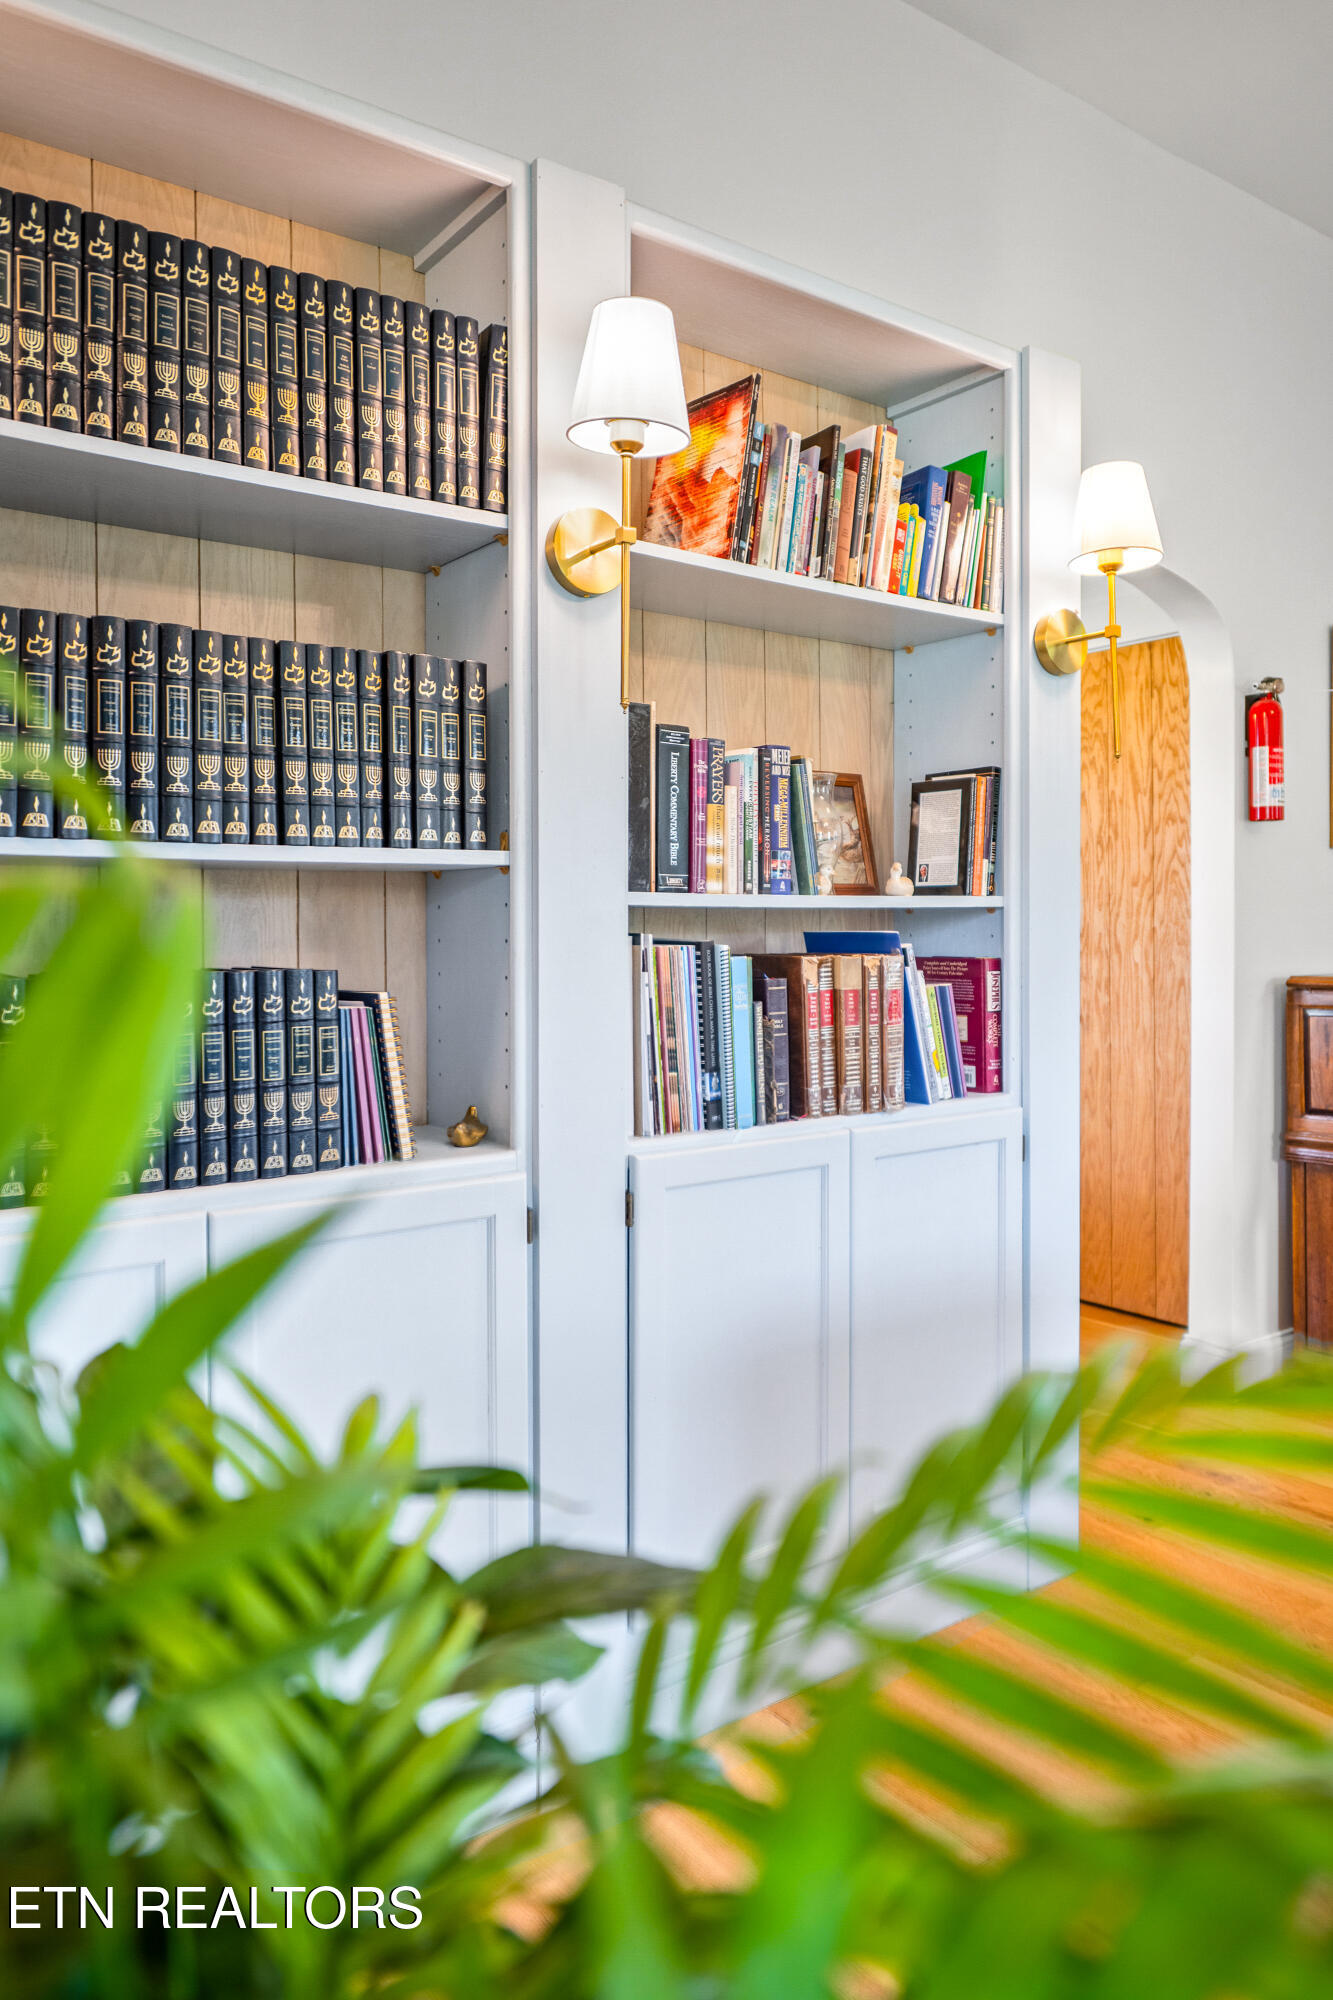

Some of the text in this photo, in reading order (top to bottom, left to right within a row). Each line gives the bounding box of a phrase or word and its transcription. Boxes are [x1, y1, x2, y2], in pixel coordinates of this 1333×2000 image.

[768, 496, 776, 522] REALM
[670, 752, 680, 783] LIBERTY
[710, 746, 724, 804] PRAYERS
[670, 785, 680, 842] COMMENTARY
[778, 777, 789, 848] MEGA-MILLENNIUM
[670, 842, 679, 866] BIBLE
[991, 972, 1000, 1010] JOSEPHUS
